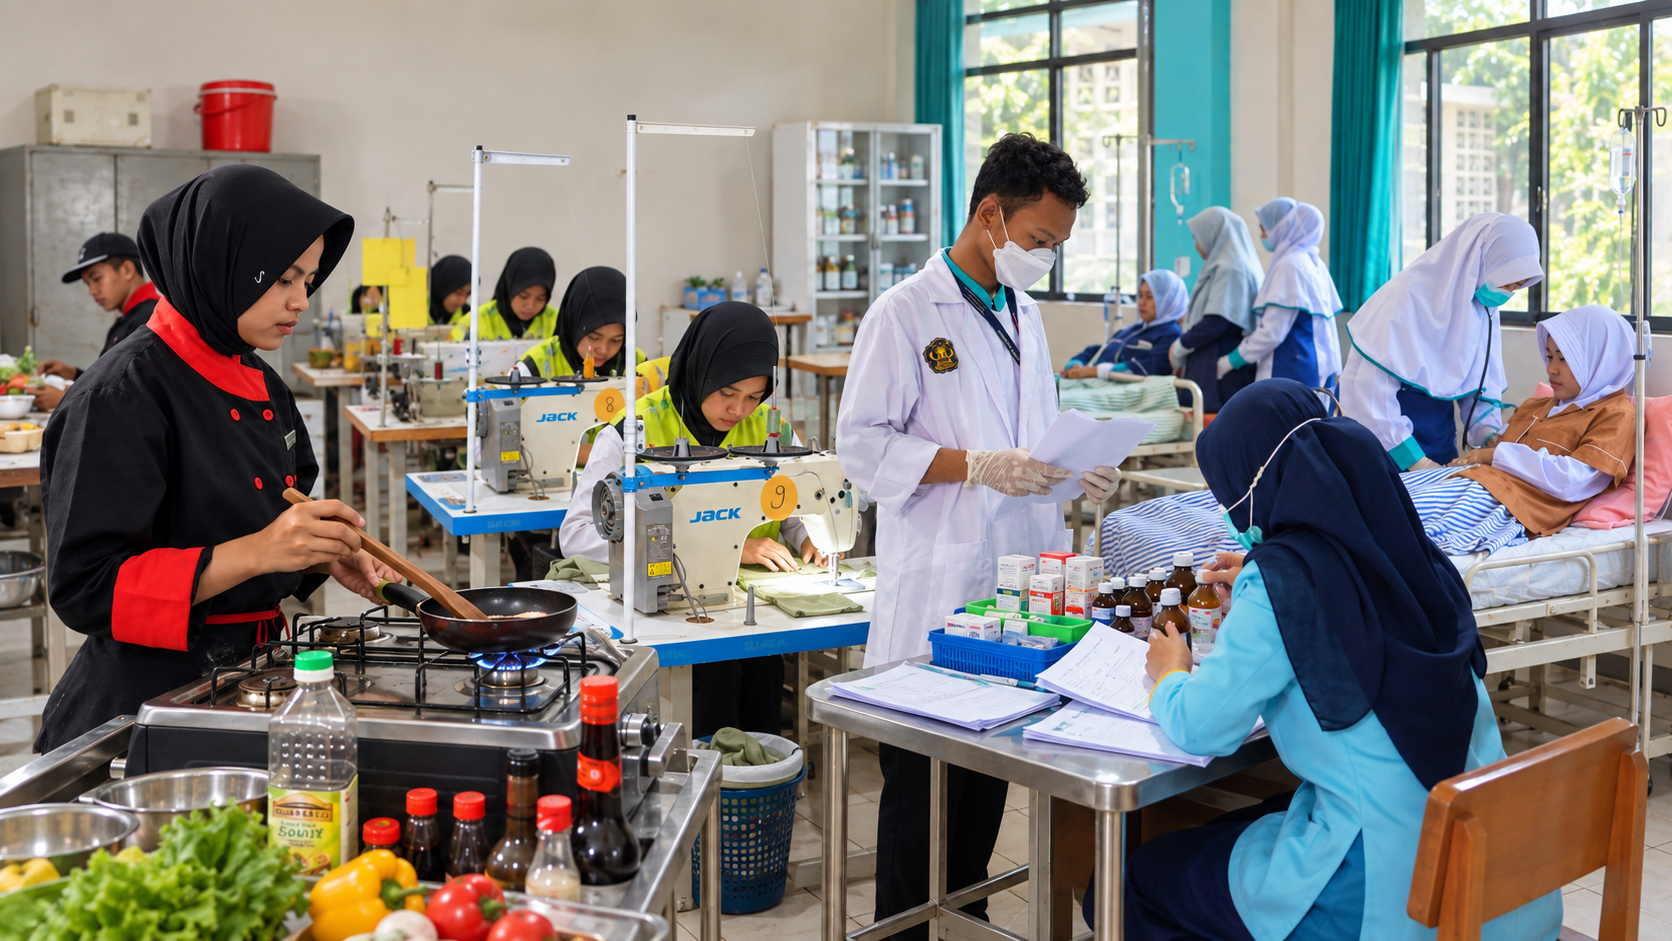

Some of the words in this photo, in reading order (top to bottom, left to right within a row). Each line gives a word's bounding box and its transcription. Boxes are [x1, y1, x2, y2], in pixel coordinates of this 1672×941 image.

[605, 396, 615, 413] 8
[536, 412, 578, 423] JACK
[770, 485, 786, 510] 9
[689, 507, 742, 524] JACK
